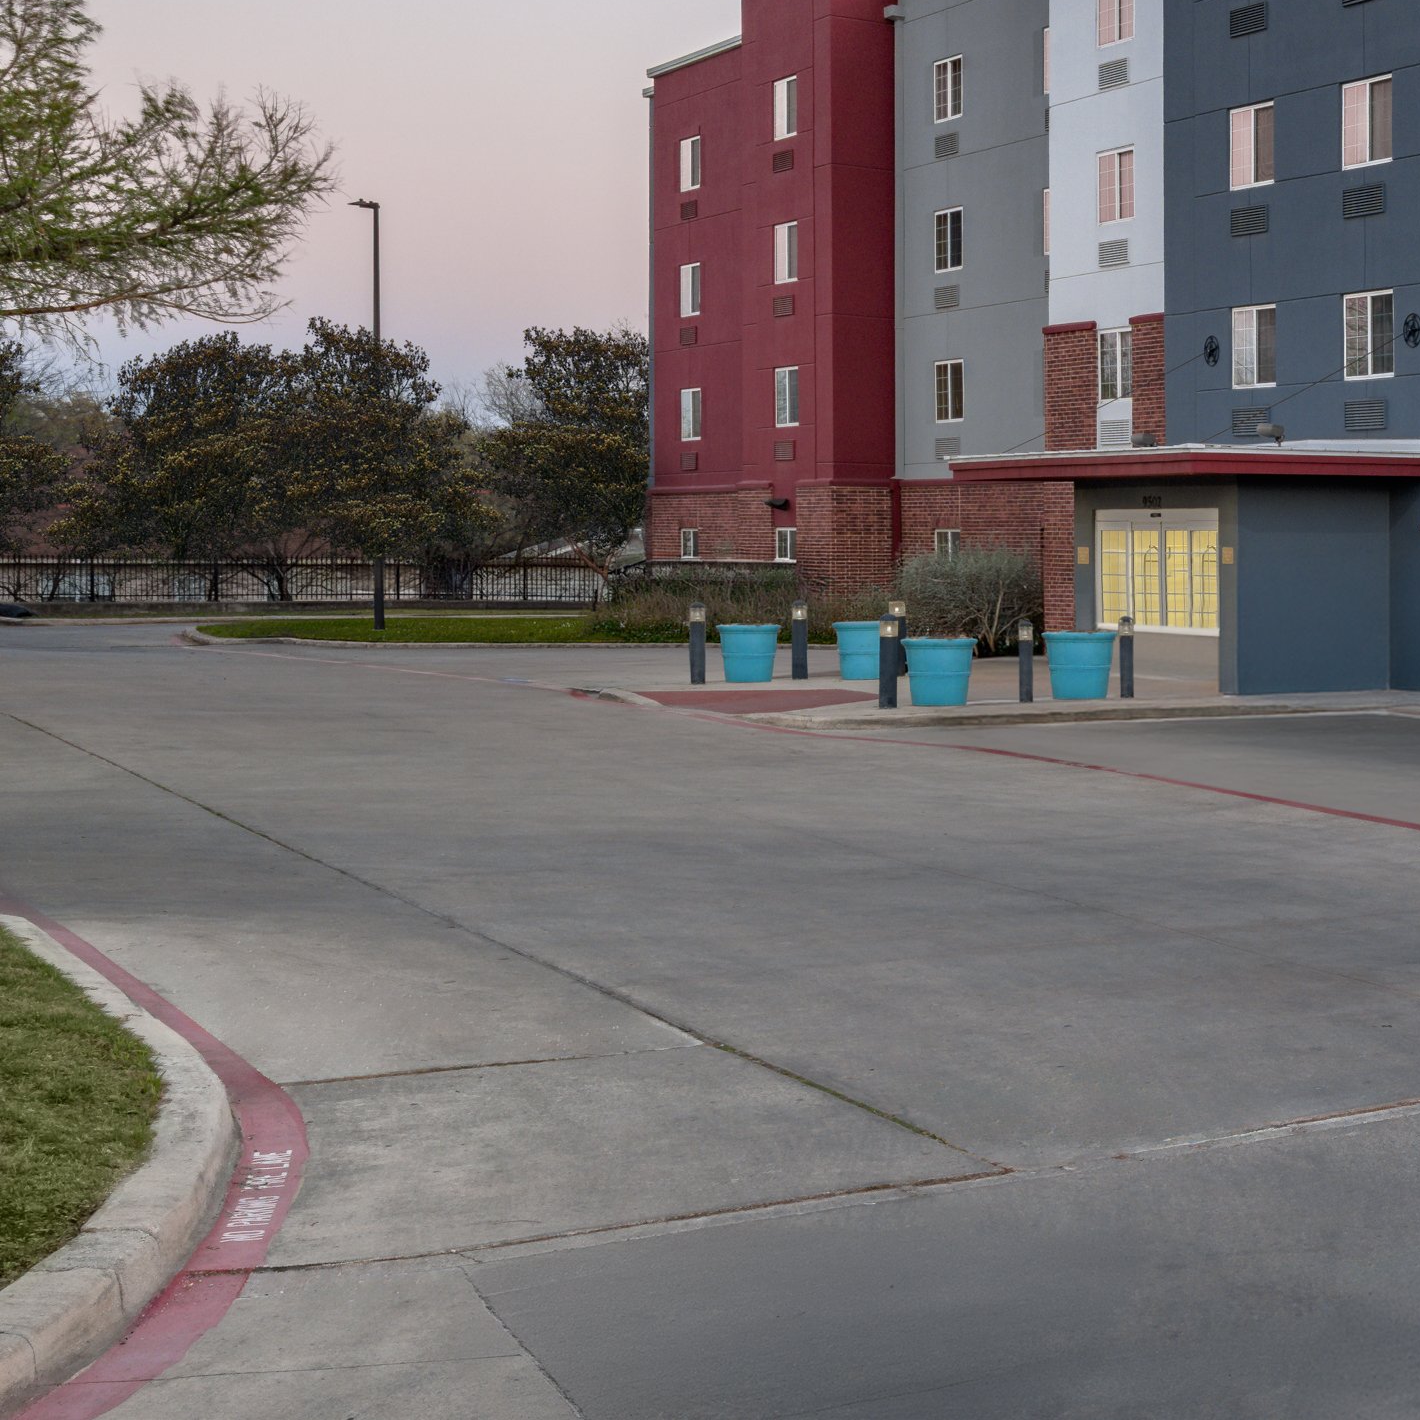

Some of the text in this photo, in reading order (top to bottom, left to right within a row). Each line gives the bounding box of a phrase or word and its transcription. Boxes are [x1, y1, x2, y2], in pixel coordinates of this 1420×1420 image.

[251, 1149, 293, 1171] LANE
[226, 1195, 281, 1228] PARKING
[219, 1229, 266, 1243] NO
